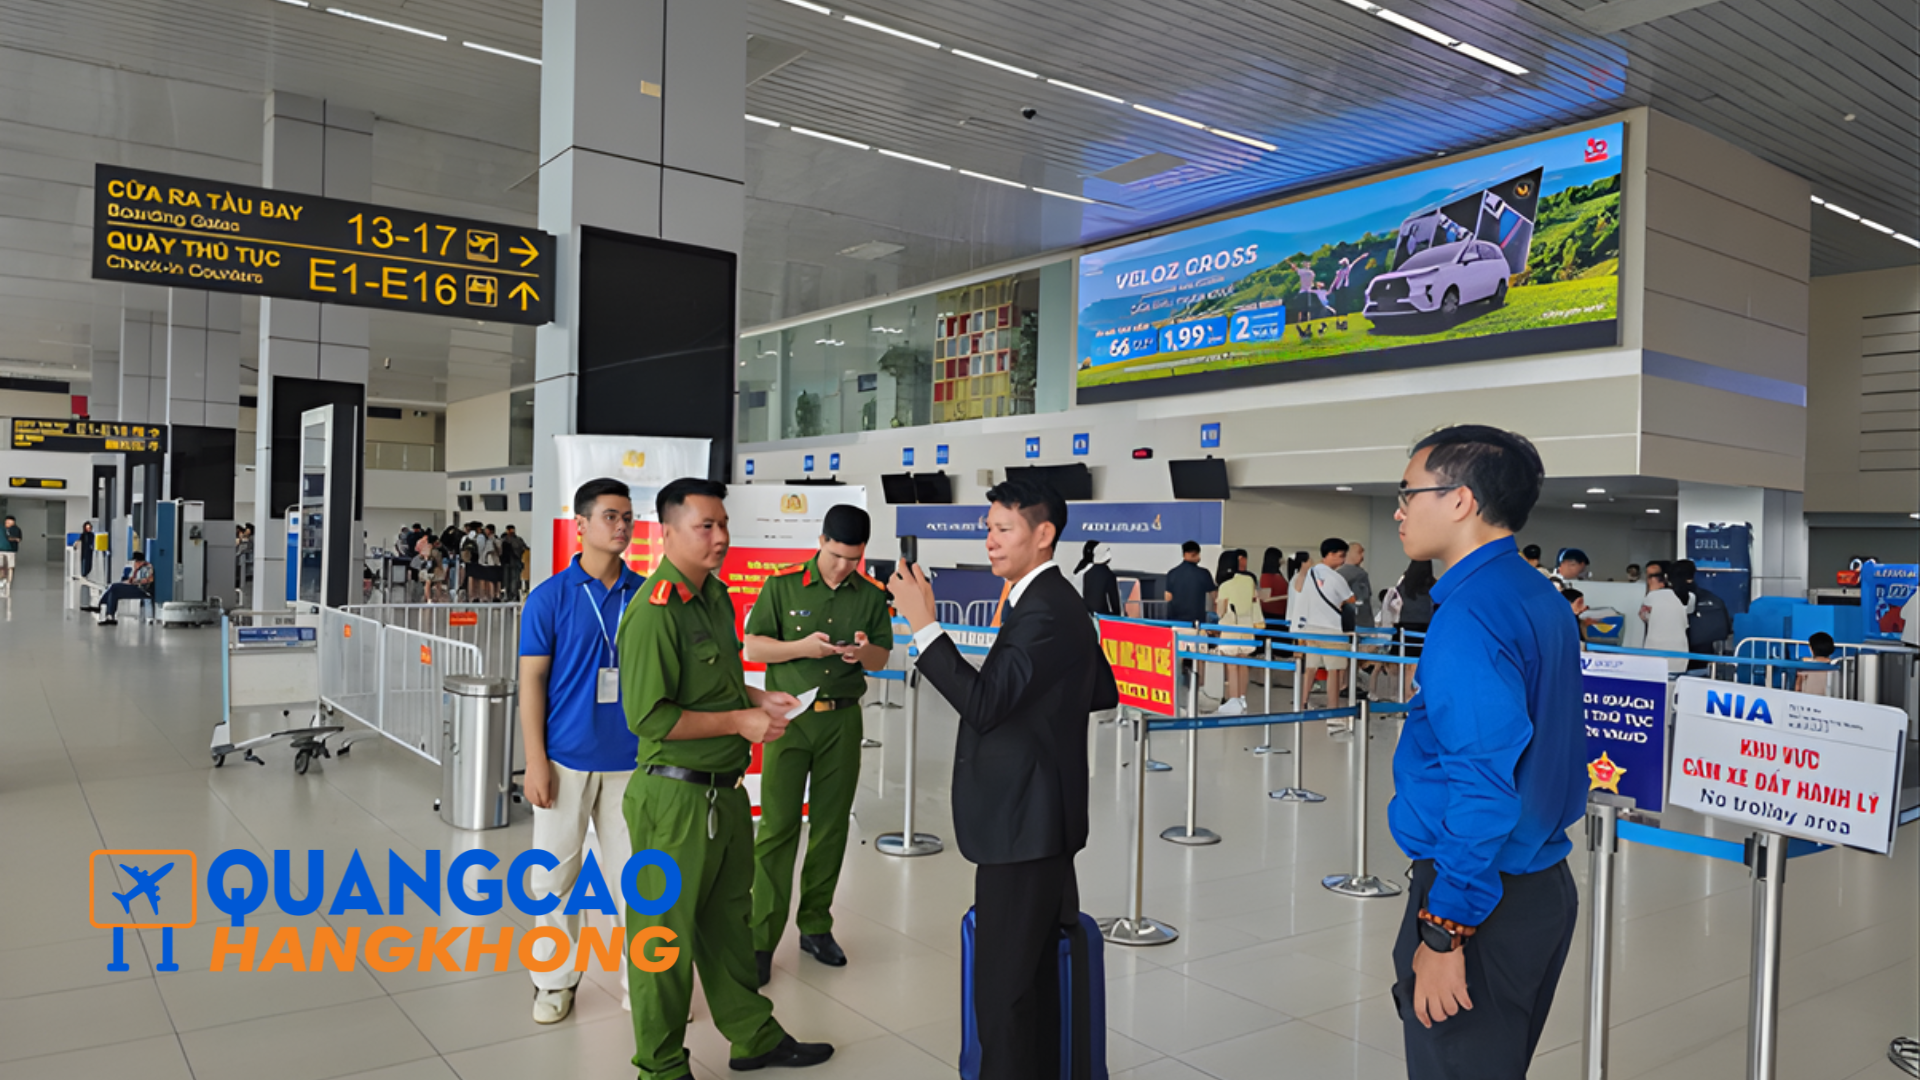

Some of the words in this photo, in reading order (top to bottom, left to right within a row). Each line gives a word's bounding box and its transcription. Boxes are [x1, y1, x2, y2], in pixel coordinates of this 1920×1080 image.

[168, 188, 202, 208] RA
[260, 201, 303, 221] BAY
[347, 213, 458, 256] 13-17
[309, 257, 458, 305] E1-E16
[1116, 261, 1180, 290] VELOZ
[1705, 689, 1773, 725] NIA
[1740, 738, 1777, 761] KHU
[1726, 766, 1748, 787] XE
[1700, 788, 1726, 808] No
